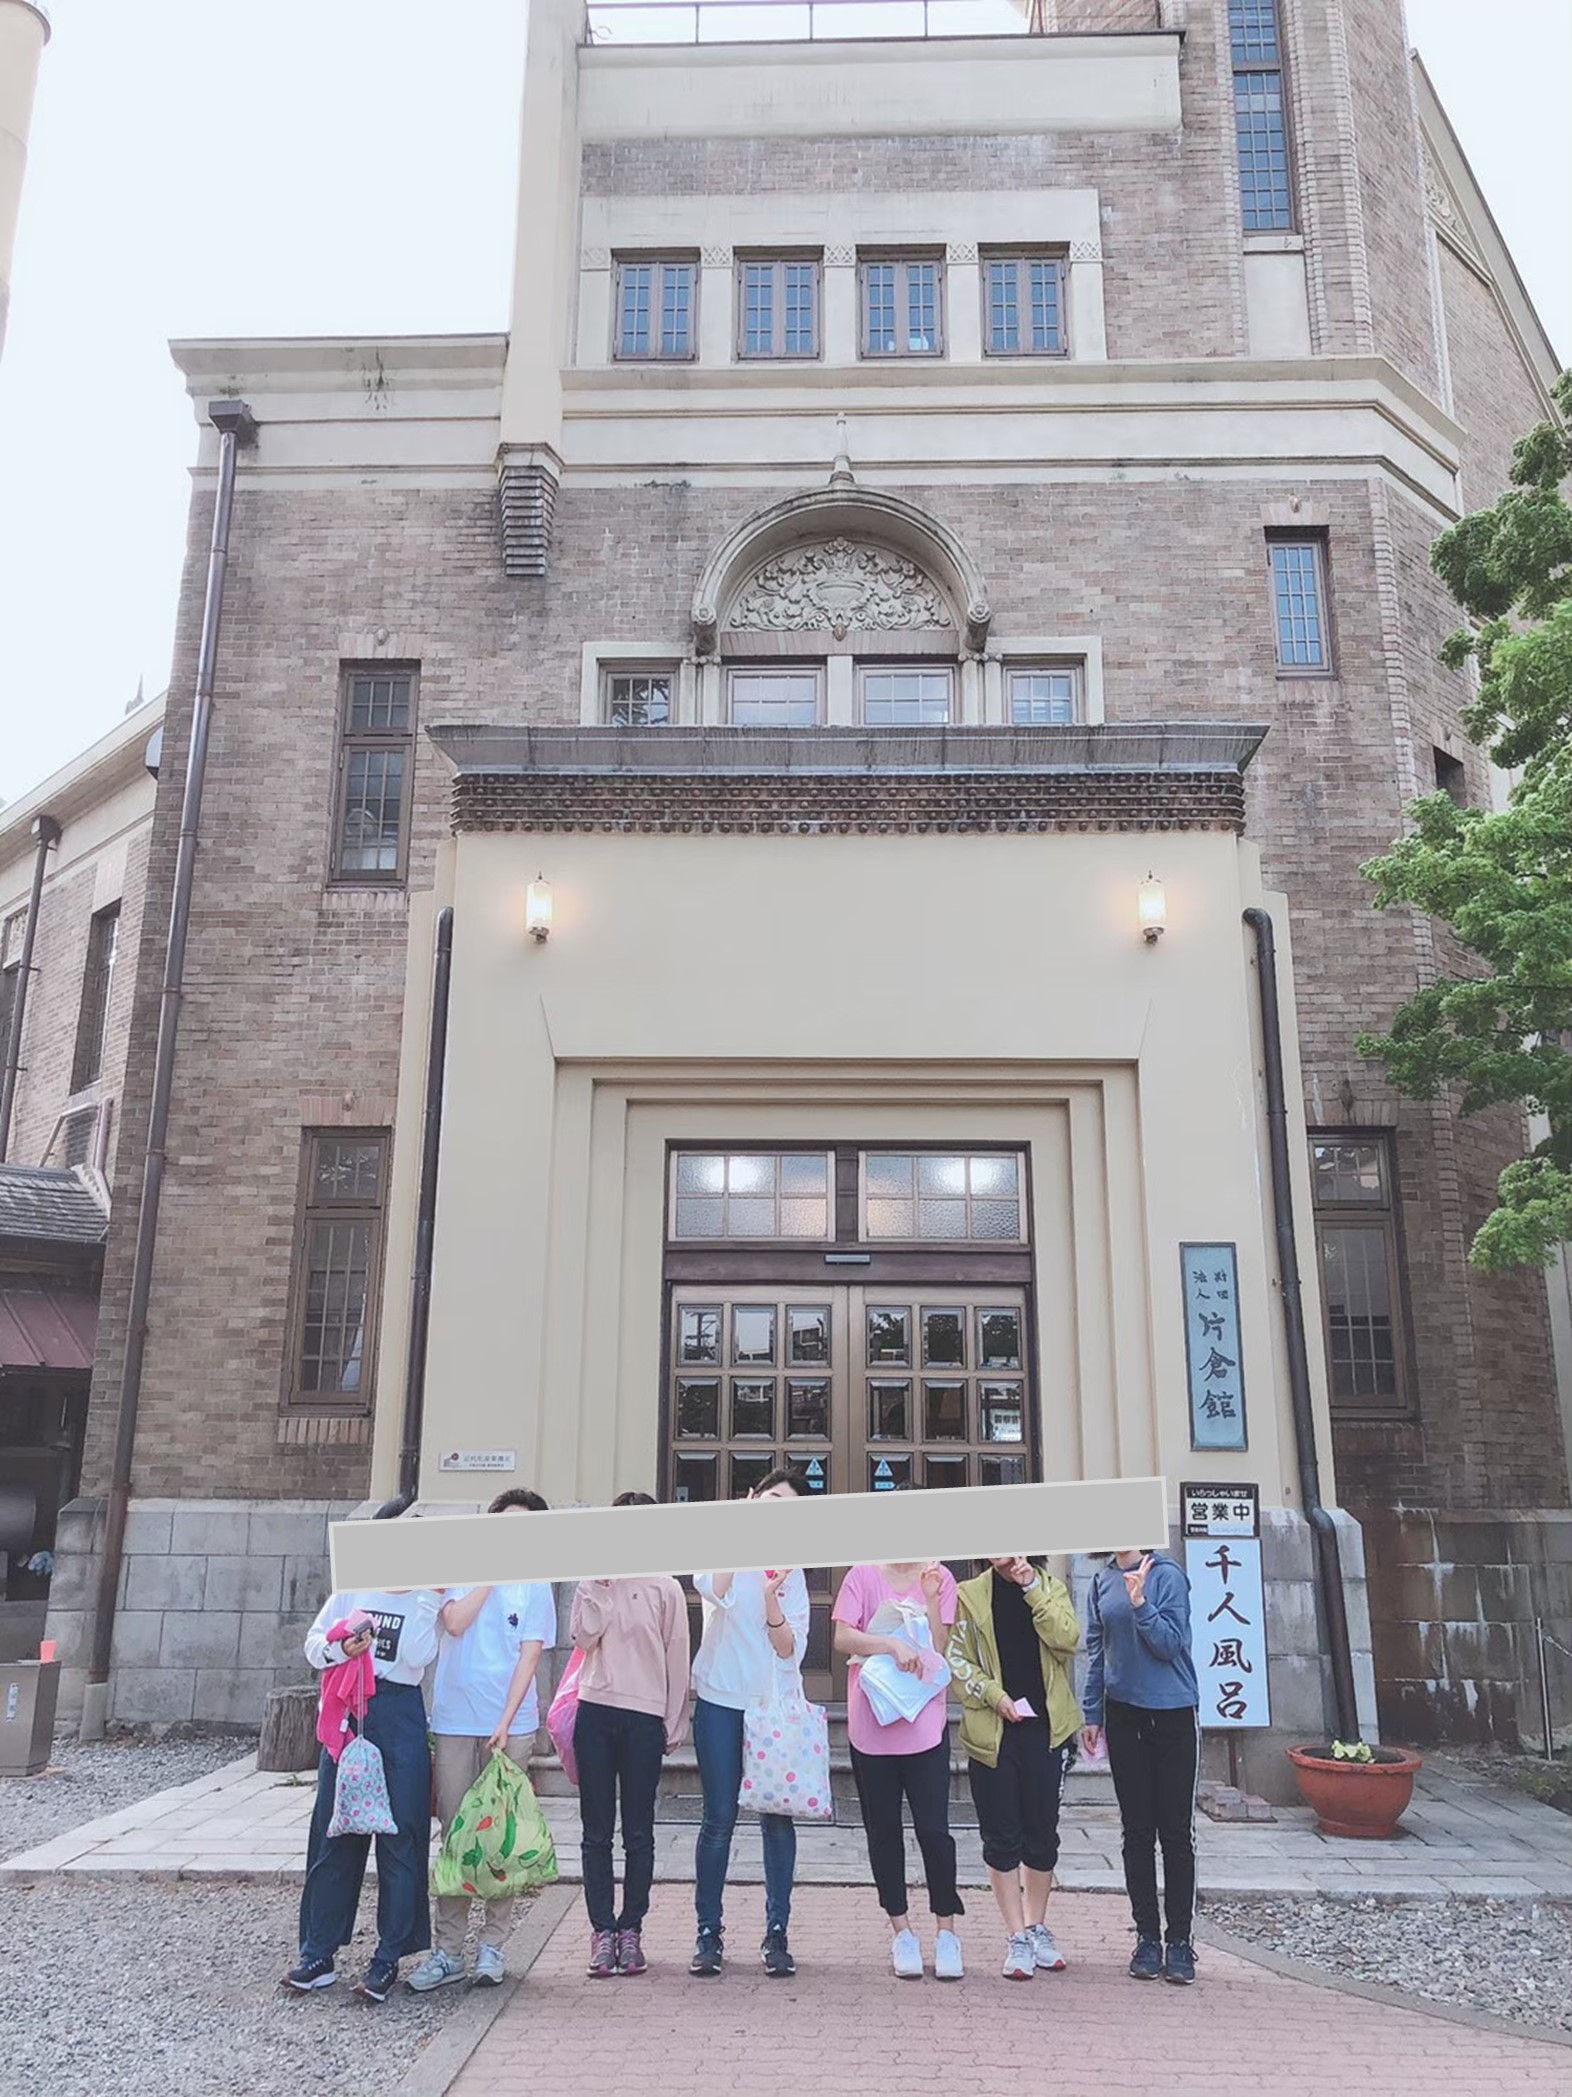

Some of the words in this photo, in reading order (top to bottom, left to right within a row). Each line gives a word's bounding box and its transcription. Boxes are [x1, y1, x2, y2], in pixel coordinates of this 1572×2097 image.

[1198, 1312, 1236, 1419] 片倉館
[1191, 1502, 1250, 1521] 営業中
[1205, 1544, 1253, 1720] 千人風呂
